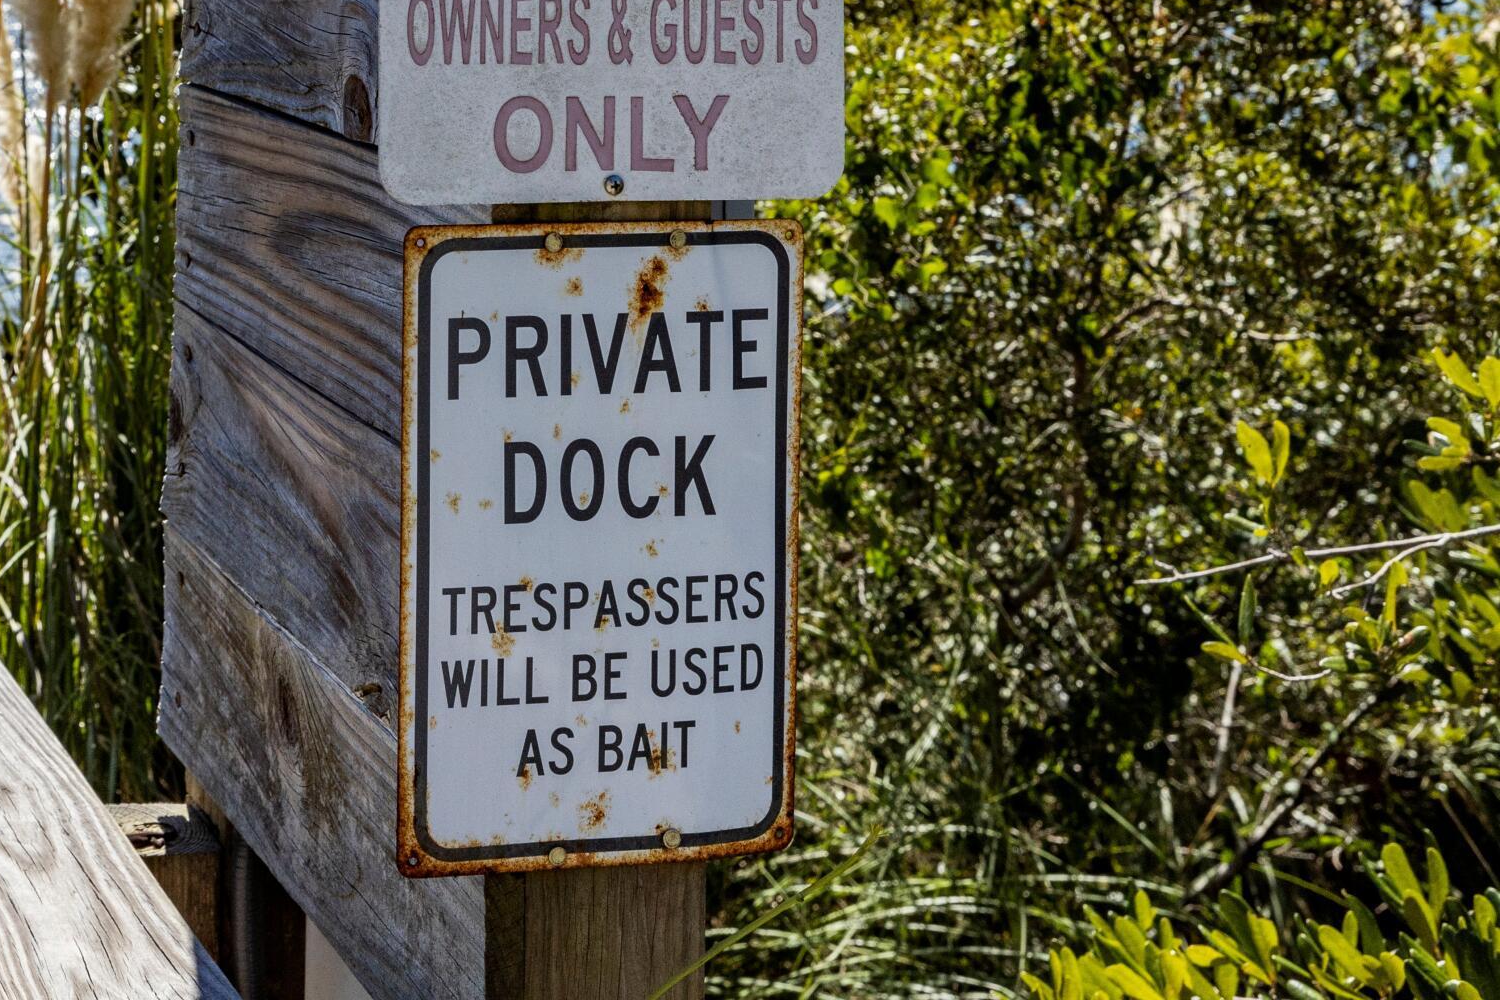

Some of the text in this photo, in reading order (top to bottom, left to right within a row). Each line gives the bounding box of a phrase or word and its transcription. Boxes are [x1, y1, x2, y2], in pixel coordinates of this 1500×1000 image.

[493, 94, 730, 174] ONLY
[447, 308, 770, 400] PRIVATE
[503, 434, 717, 525] DOCK
[441, 571, 766, 636] TRESPASSERS
[440, 642, 765, 709] WILL BE USED
[516, 719, 697, 778] AS BAIT
